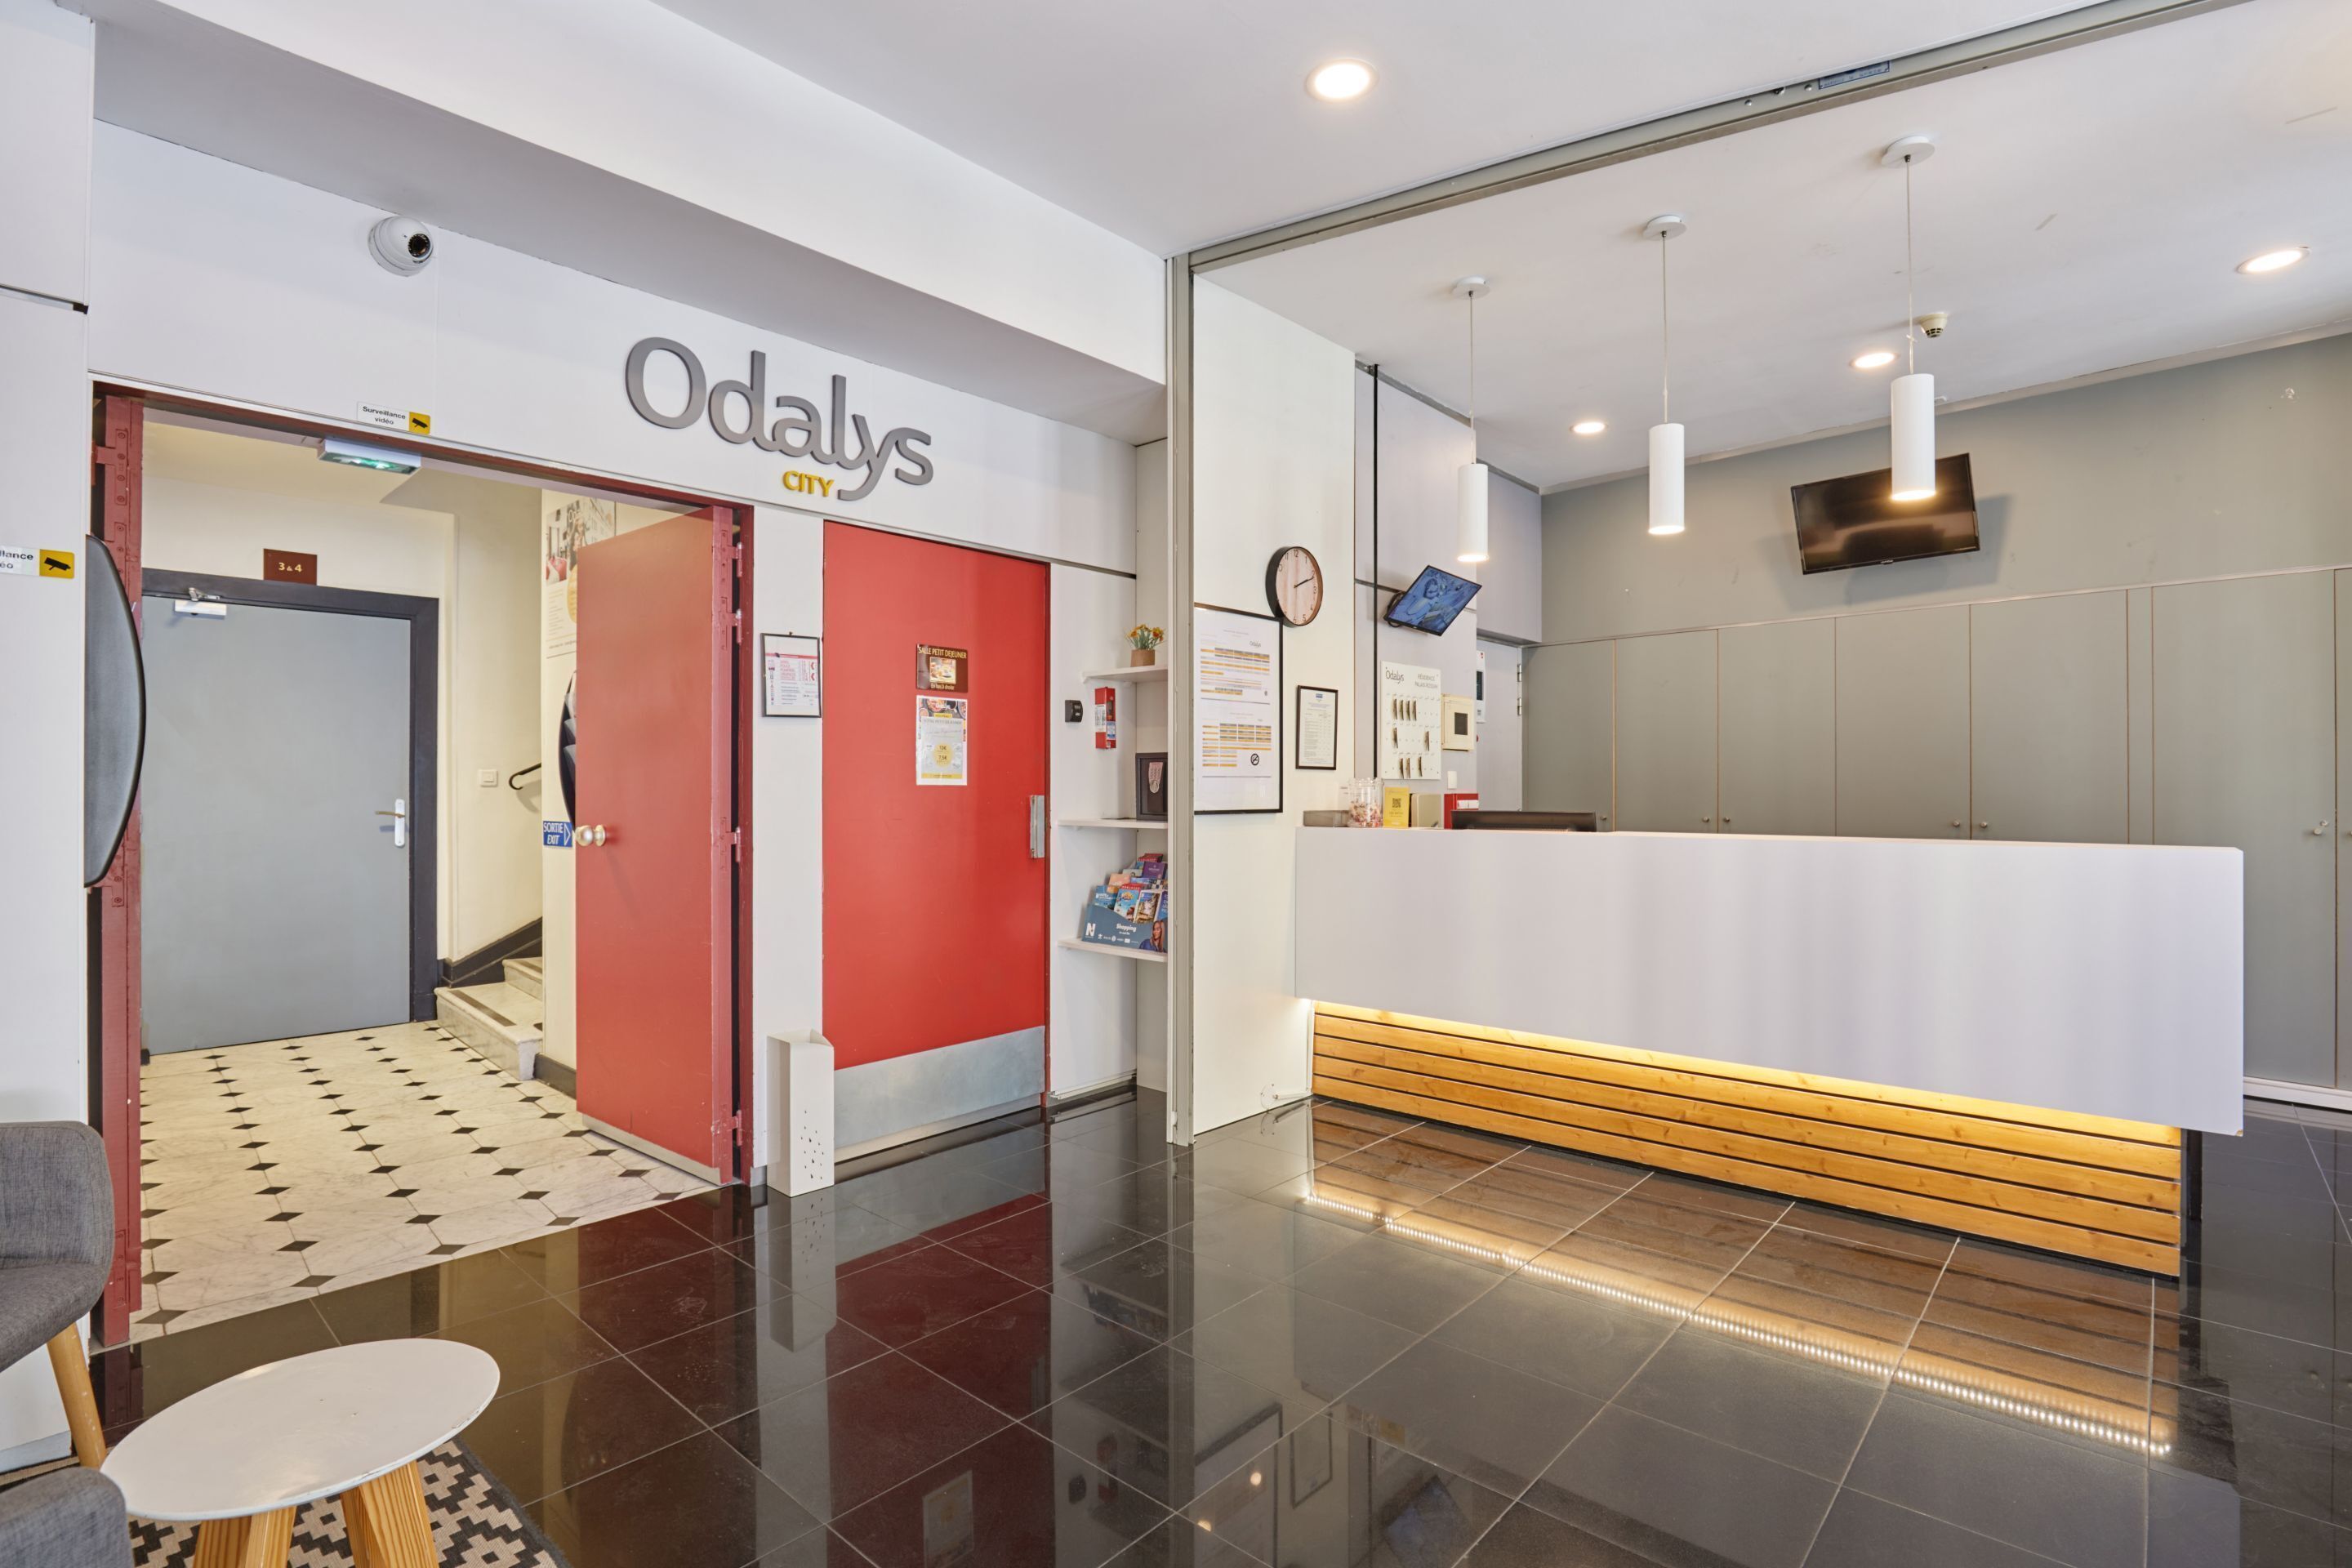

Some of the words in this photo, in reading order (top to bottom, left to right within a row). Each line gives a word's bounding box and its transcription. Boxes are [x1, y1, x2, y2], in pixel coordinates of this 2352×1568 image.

[363, 406, 406, 420] Surveillance
[625, 336, 933, 501] Odalys
[375, 417, 394, 425] vidéo
[782, 470, 835, 497] CITY
[278, 562, 285, 571] 3
[294, 564, 302, 572] 4
[918, 646, 932, 655] SALLE
[932, 648, 944, 657] PETIT
[1385, 669, 1405, 684] Odalys
[543, 822, 564, 833] SORTIE
[547, 834, 560, 844] EXIT
